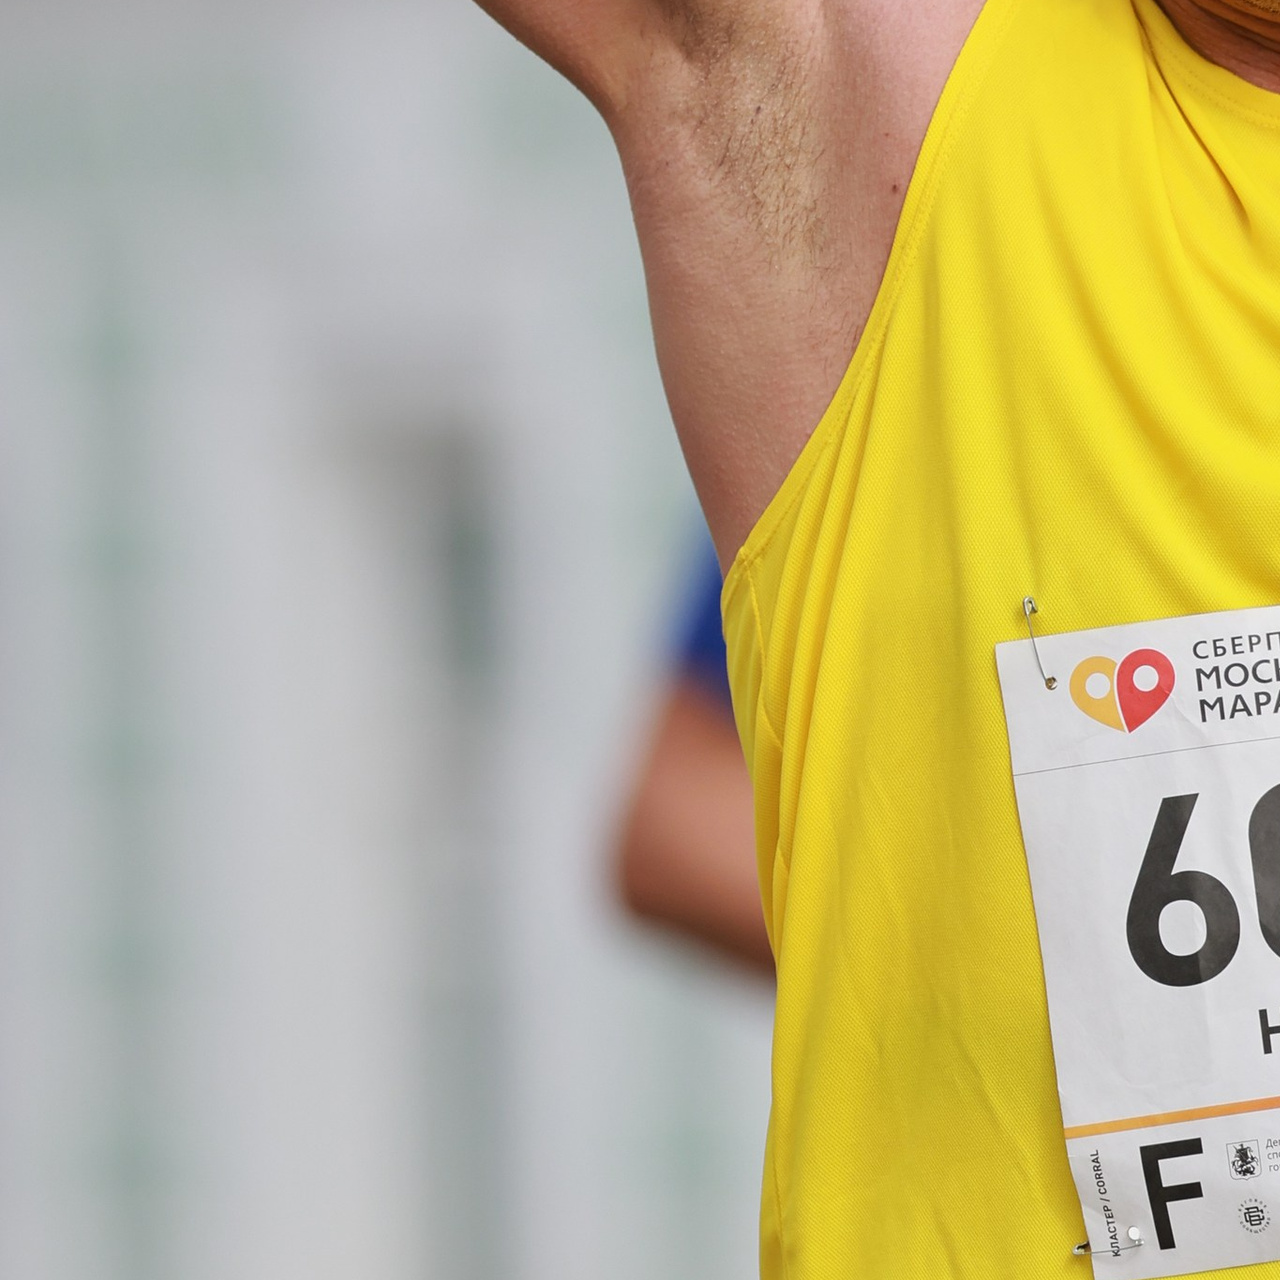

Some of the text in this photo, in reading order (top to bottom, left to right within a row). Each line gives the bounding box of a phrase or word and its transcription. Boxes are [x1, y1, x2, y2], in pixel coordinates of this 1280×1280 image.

[1090, 1149, 1107, 1195] CORRAL
[1139, 1137, 1203, 1251] F
[1103, 1205, 1121, 1257] КЛАСТЕР
